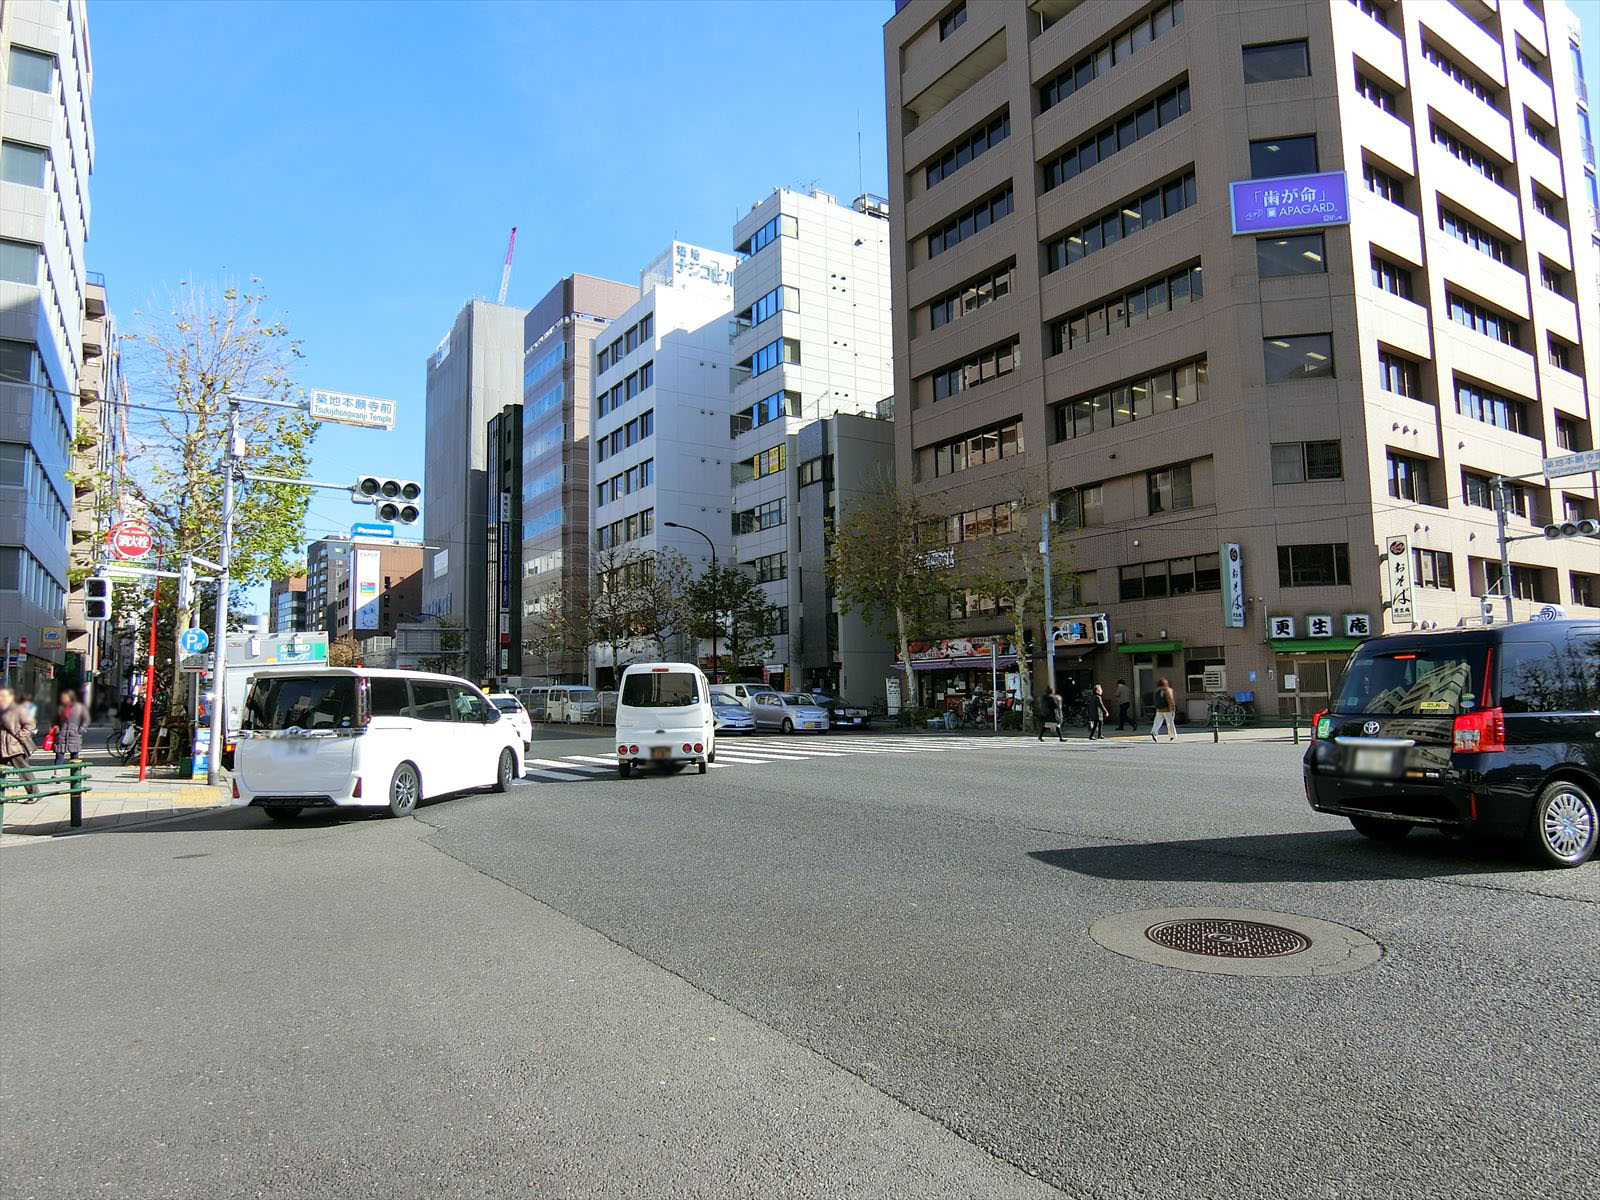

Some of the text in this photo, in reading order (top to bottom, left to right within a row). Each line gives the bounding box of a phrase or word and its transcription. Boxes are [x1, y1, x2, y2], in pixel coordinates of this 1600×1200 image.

[1279, 203, 1334, 216] APAGARD
[316, 393, 392, 414] 築地本願寺前
[315, 405, 392, 423] Tsukijihongwanji Temple
[118, 535, 149, 549] 消火栓
[1392, 562, 1411, 605] おそば
[1275, 617, 1368, 636] 更生庵
[186, 633, 199, 650] P
